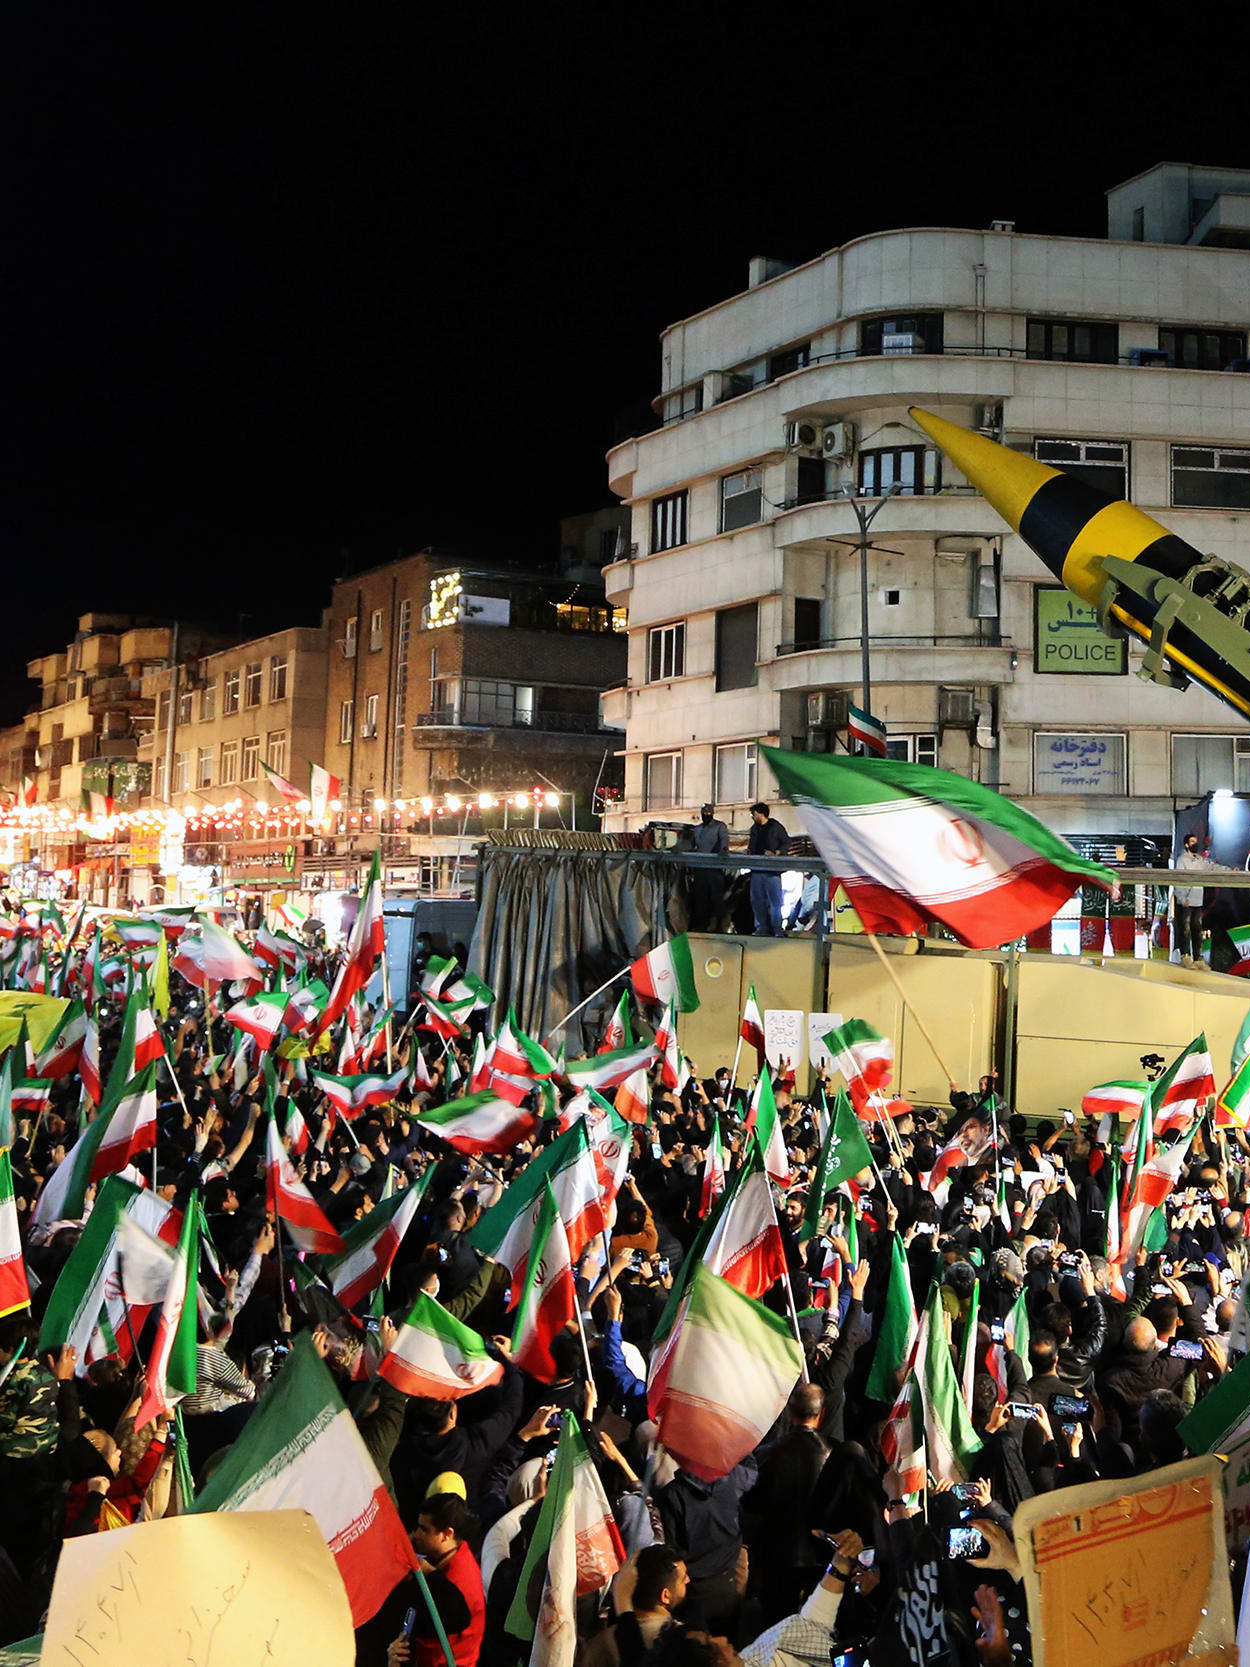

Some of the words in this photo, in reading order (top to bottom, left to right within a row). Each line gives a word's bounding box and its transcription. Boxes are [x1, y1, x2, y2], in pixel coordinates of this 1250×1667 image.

[1045, 643, 1117, 661] POLICE
[1050, 737, 1107, 757] دفترخانه
[1053, 760, 1078, 769] رسمی
[1080, 757, 1102, 767] اسناد
